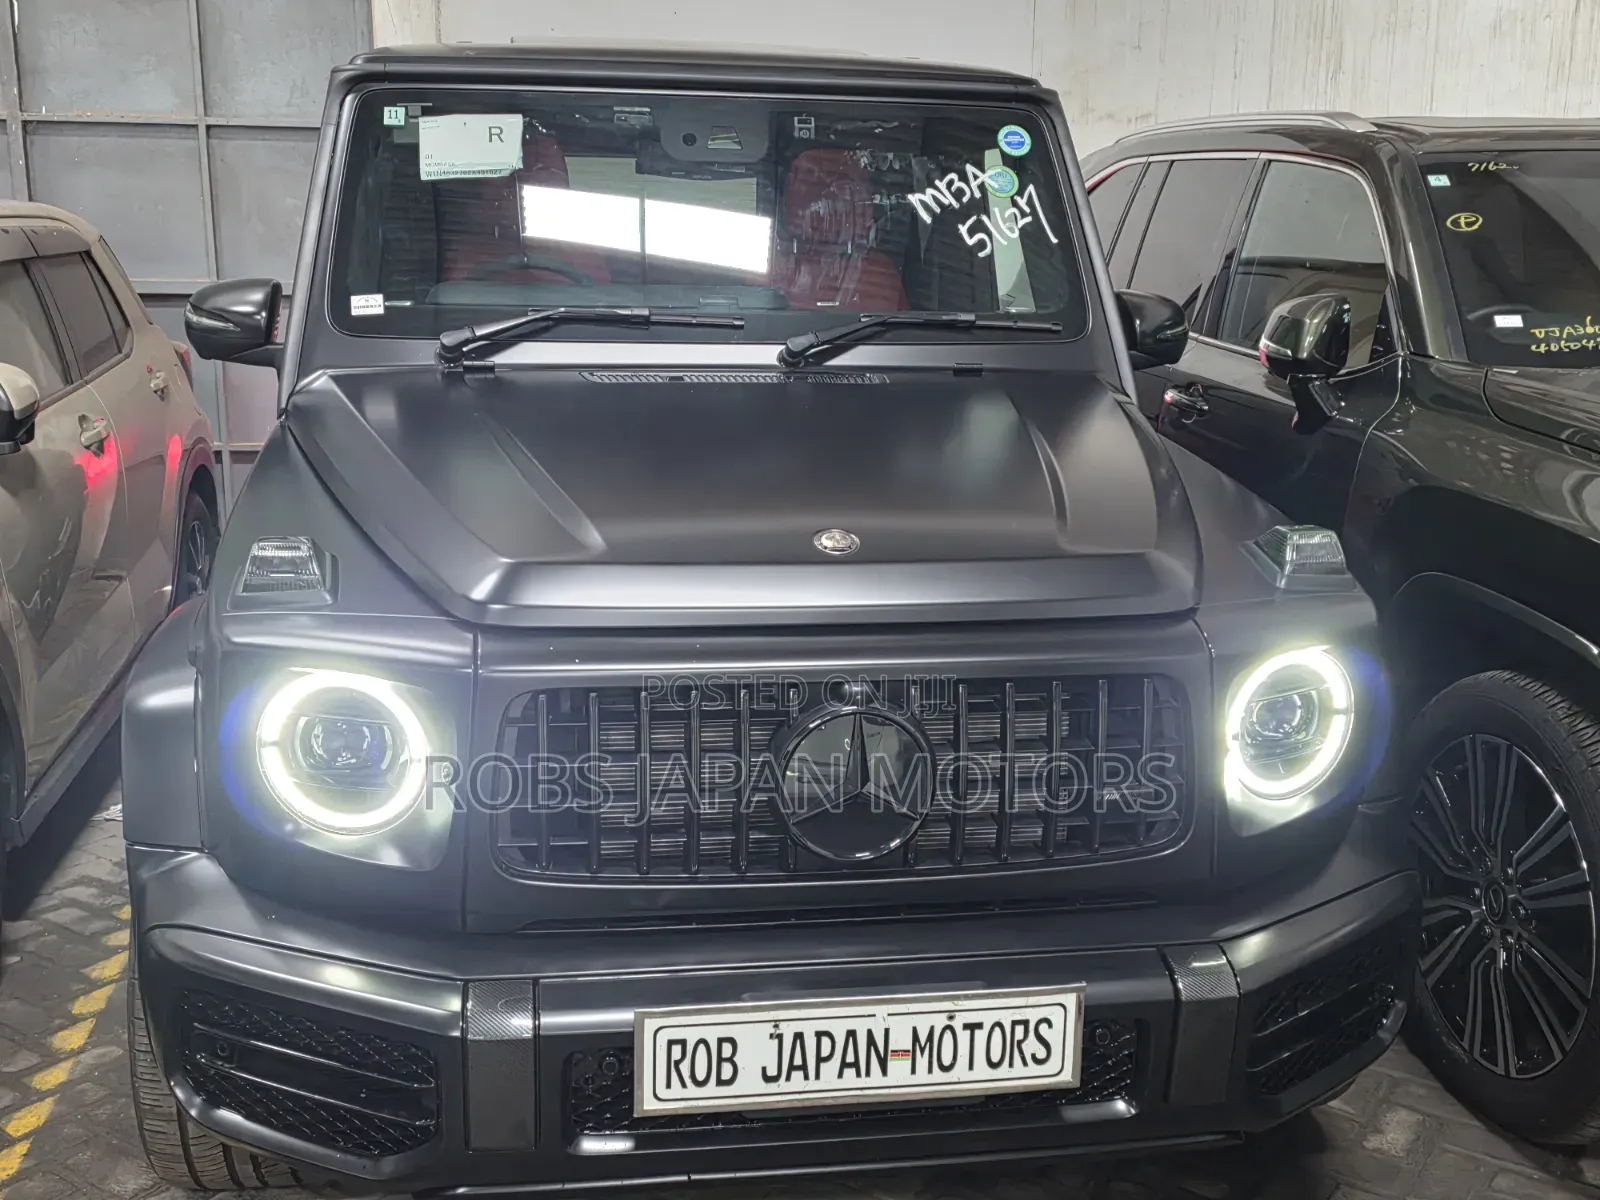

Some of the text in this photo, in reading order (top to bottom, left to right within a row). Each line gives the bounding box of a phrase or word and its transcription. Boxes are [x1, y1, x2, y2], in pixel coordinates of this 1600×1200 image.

[387, 109, 399, 119] 11
[488, 125, 505, 143] R
[906, 163, 1002, 224] MBA
[957, 183, 1059, 257] 51627
[665, 1016, 1054, 1090] ROB JAPAN MOTORS
